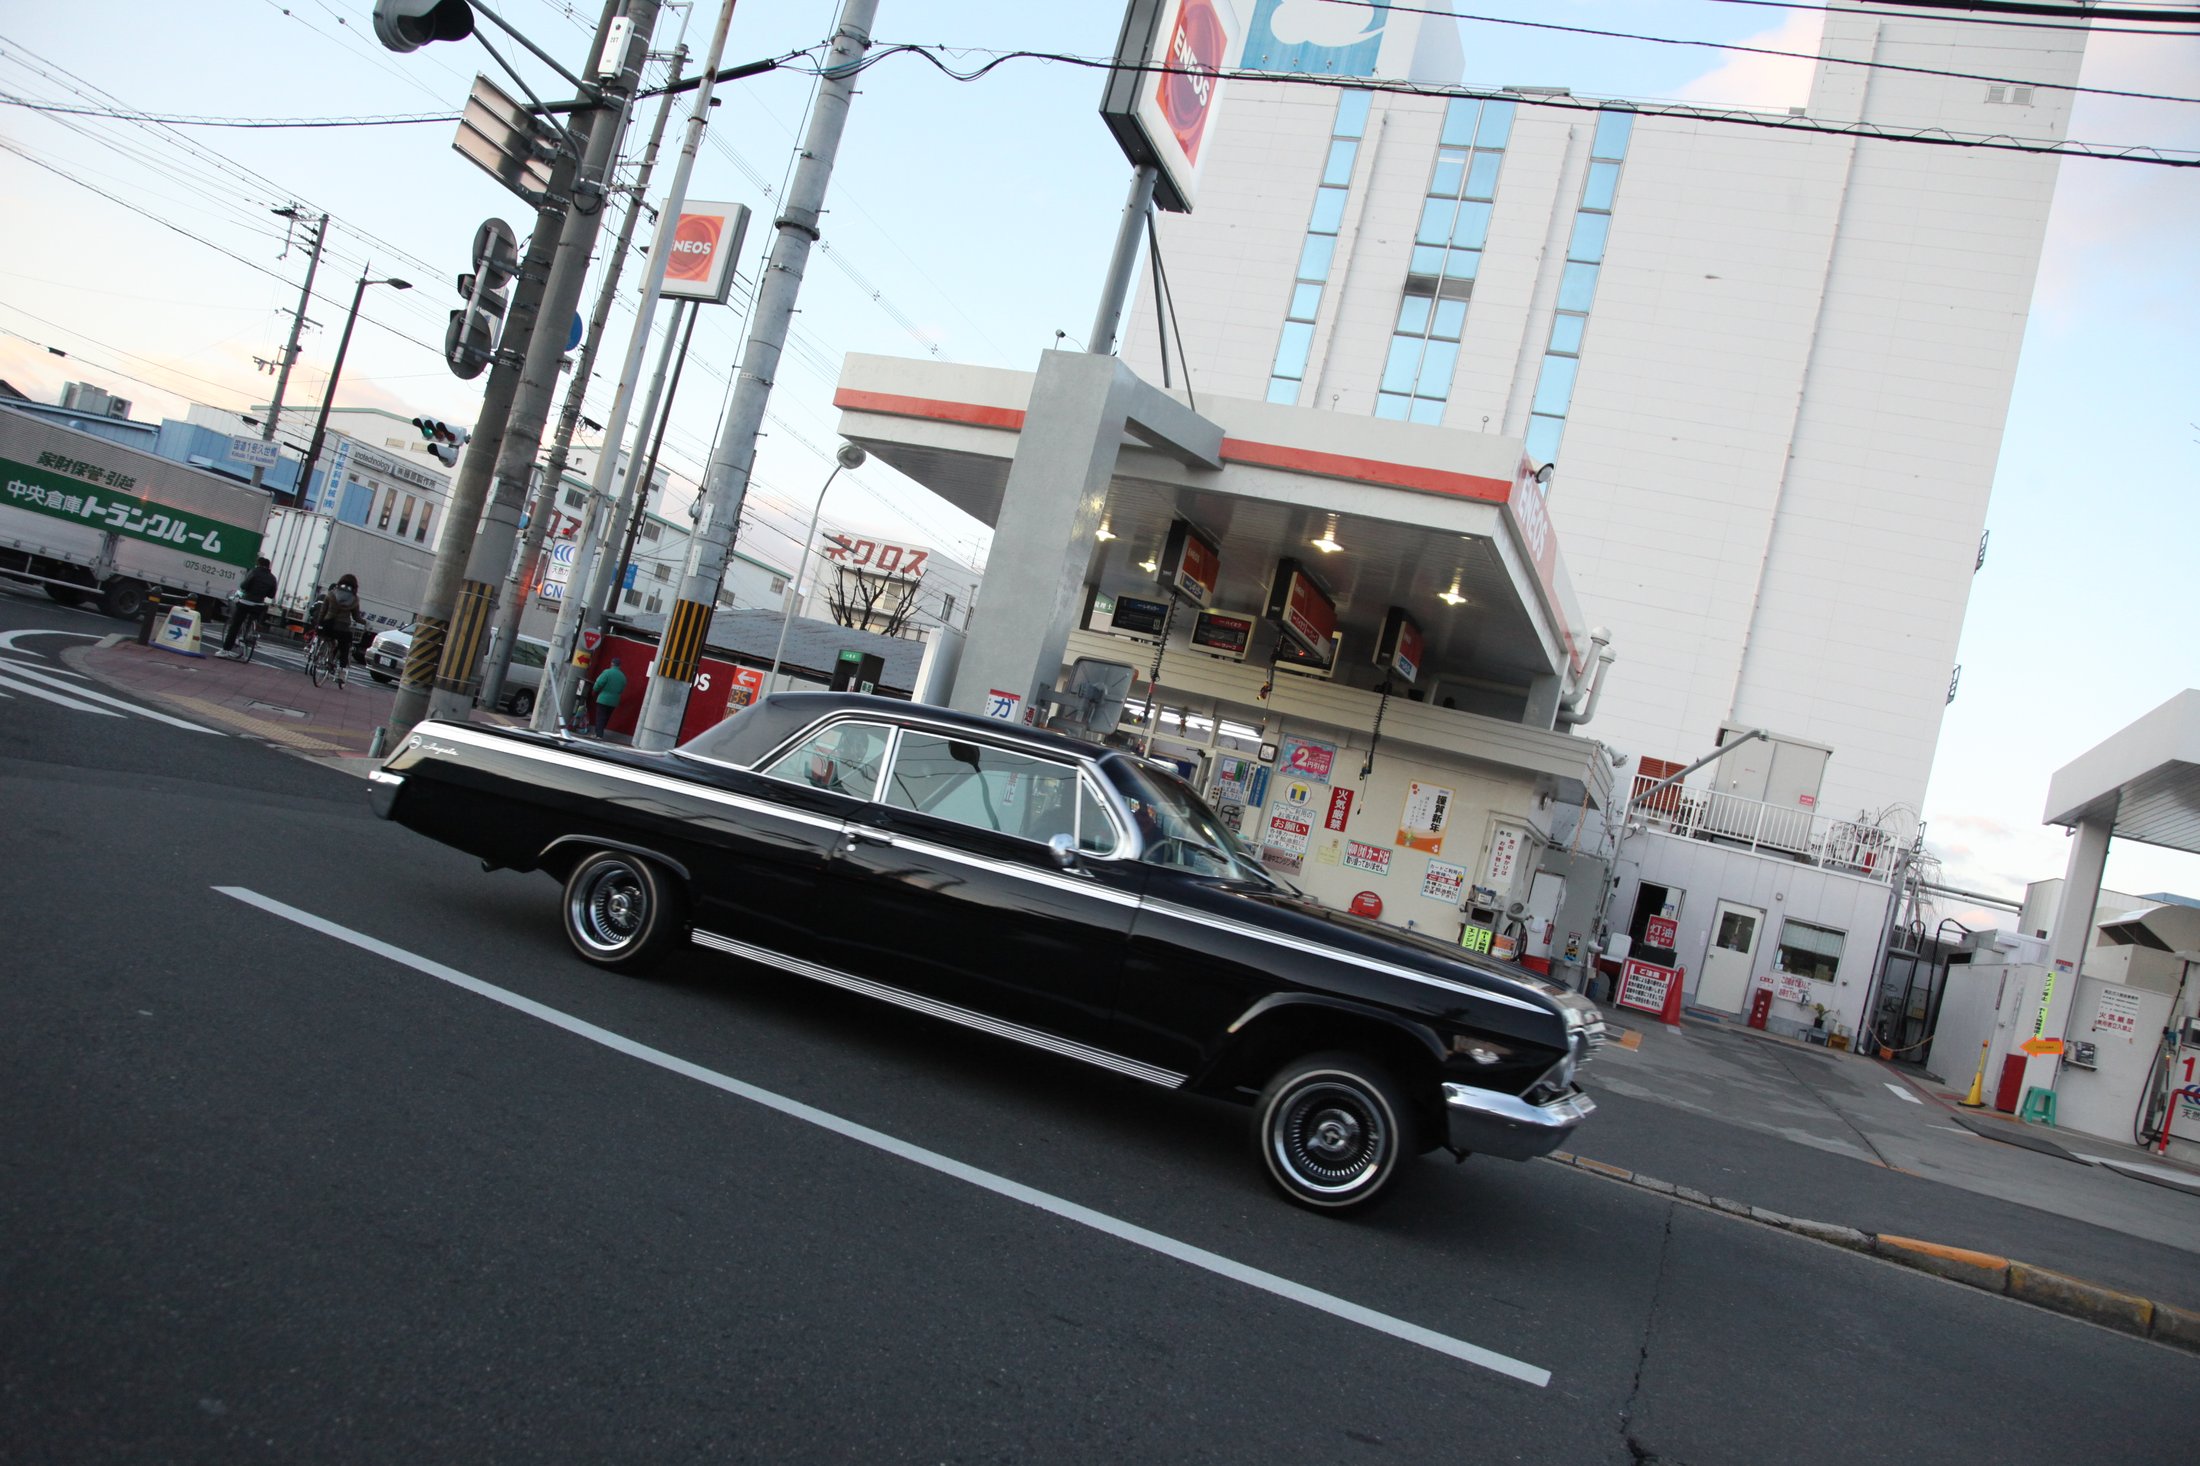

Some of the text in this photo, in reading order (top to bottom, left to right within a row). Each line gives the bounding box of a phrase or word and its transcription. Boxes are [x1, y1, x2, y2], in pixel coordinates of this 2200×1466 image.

[1174, 24, 1210, 106] ENEOS
[672, 239, 712, 255] NEOS
[234, 439, 278, 459] 国道1号久世橋
[7, 479, 221, 553] 中央倉庫トランクルーム
[1517, 470, 1549, 562] ENEOS
[826, 534, 929, 576] ネグロス
[543, 583, 565, 598] CN
[1294, 747, 1310, 767] 2
[1329, 789, 1349, 831] 火気厳禁
[1429, 794, 1448, 833] 謹賀新年
[1273, 818, 1307, 833] お願い
[1649, 923, 1674, 939] 灯油
[2182, 1056, 2196, 1082] 1
